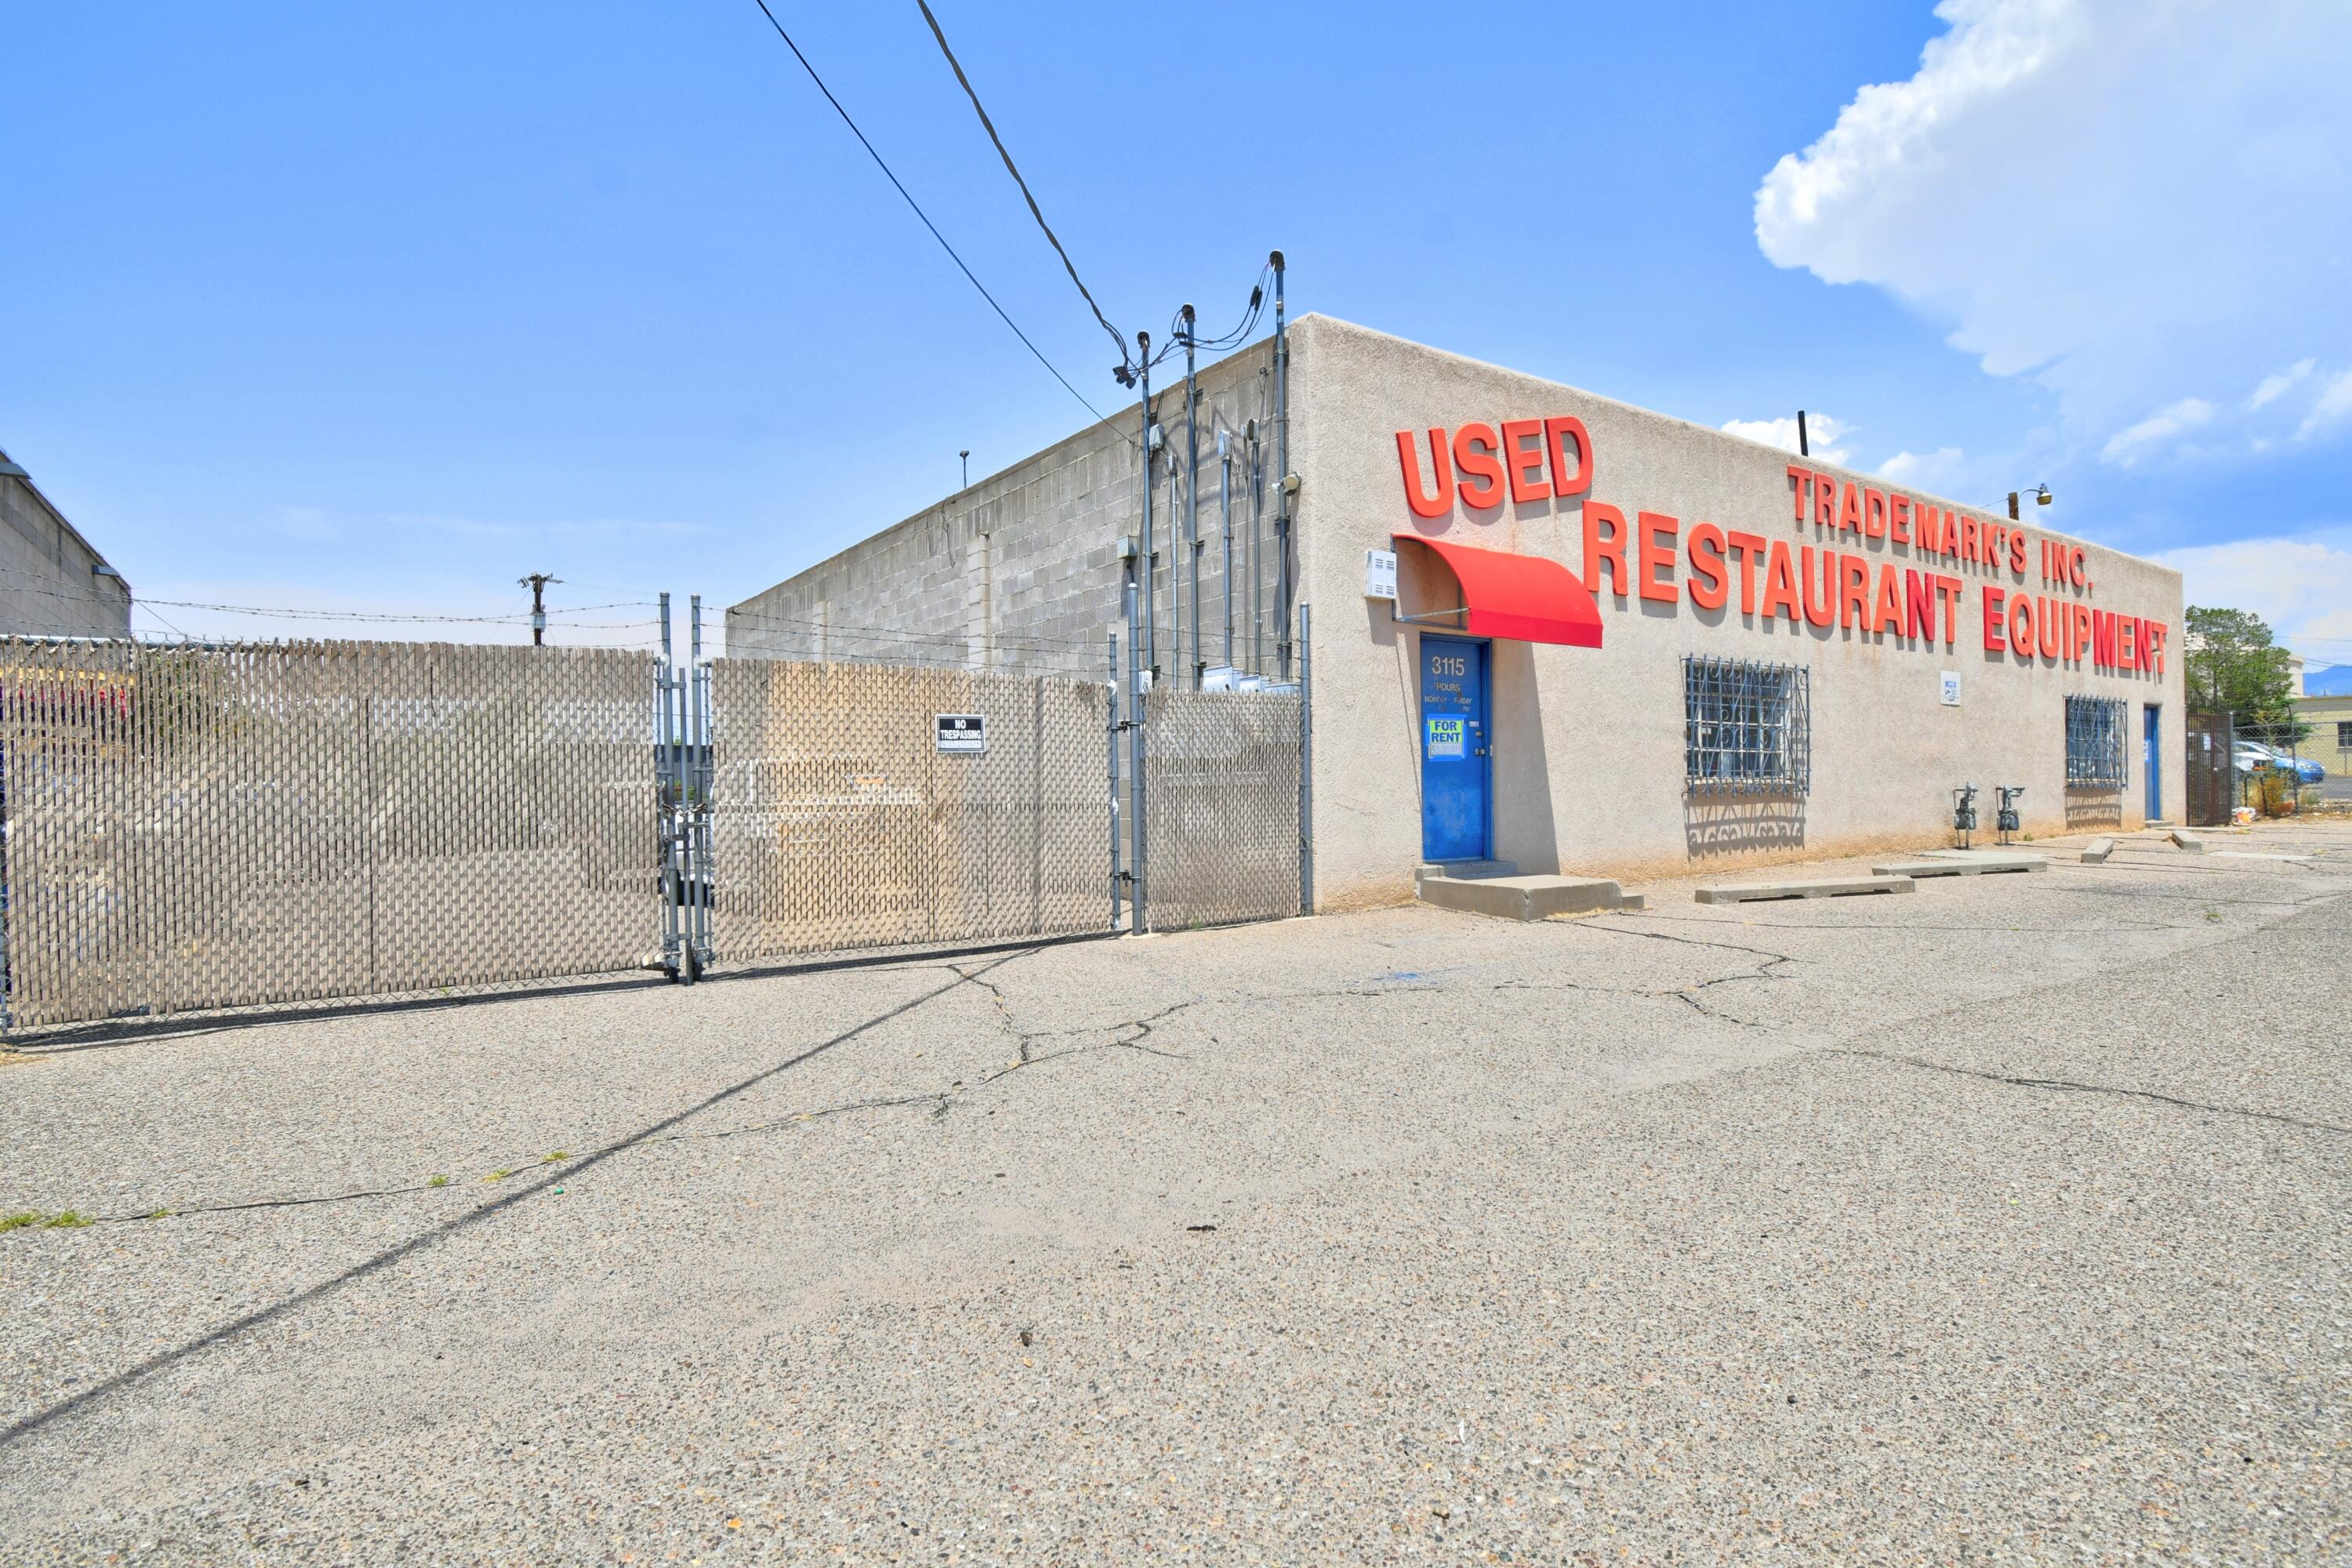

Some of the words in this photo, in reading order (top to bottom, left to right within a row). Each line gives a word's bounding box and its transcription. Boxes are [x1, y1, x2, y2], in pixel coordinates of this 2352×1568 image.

[1396, 415, 1593, 517] USED
[1788, 464, 2027, 573] TRADEMARK'S
[2042, 539, 2094, 590] INC.
[1582, 499, 1962, 644] RESTAURANT
[1983, 585, 2168, 674] EQUIPMENT
[1432, 655, 1465, 677] 3115
[1436, 682, 1461, 692] HOURS
[955, 720, 966, 729] NO
[1435, 720, 1457, 731] FOR
[941, 730, 981, 739] TRESPASSING
[1431, 732, 1461, 742] RENT
